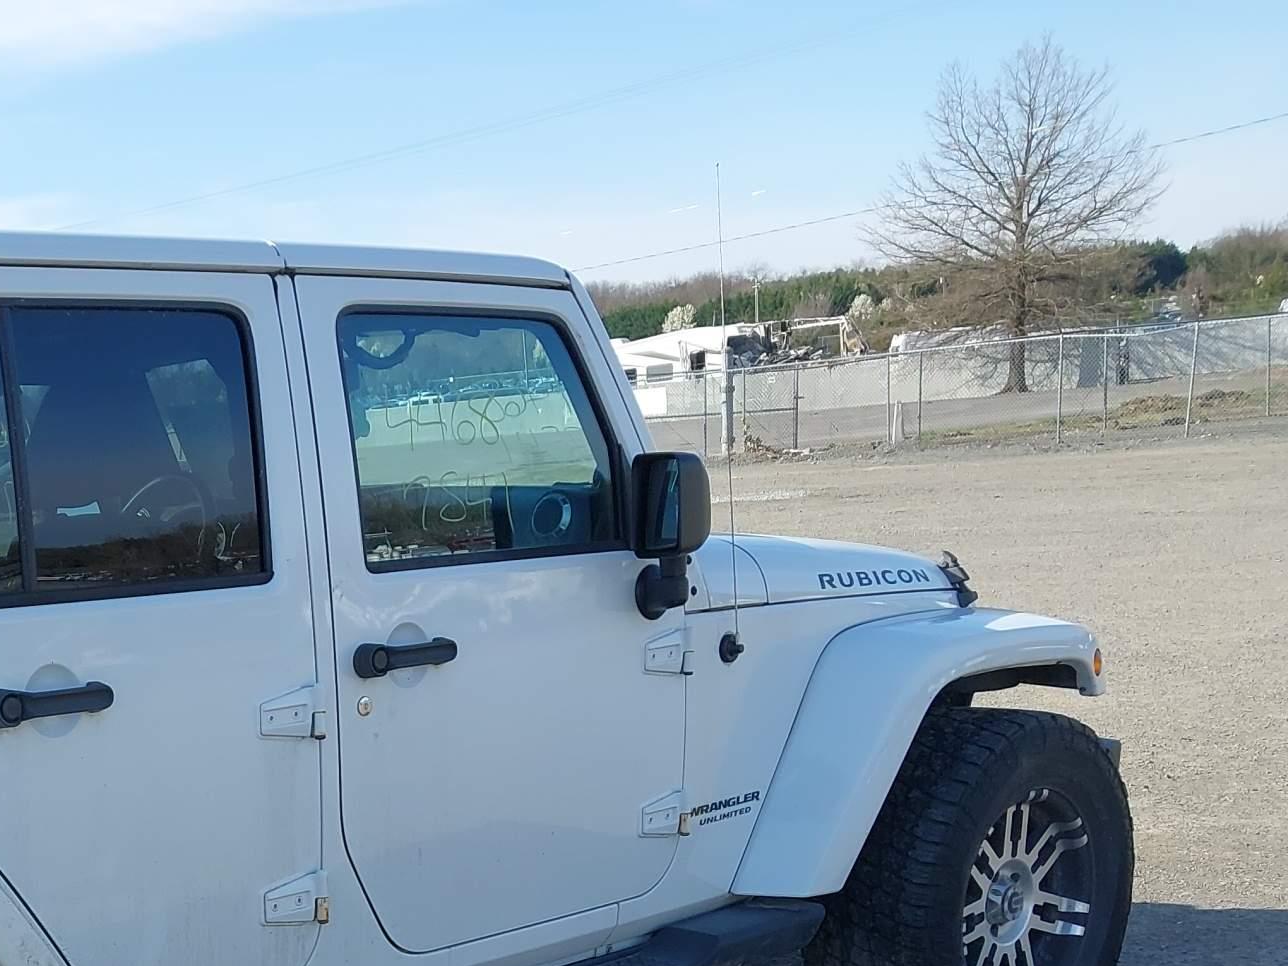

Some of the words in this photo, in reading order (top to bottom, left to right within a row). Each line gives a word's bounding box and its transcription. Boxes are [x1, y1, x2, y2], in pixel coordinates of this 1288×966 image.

[817, 569, 930, 589] RUBICON
[690, 791, 760, 817] WRANGLER
[699, 807, 751, 826] UNLIMITED
